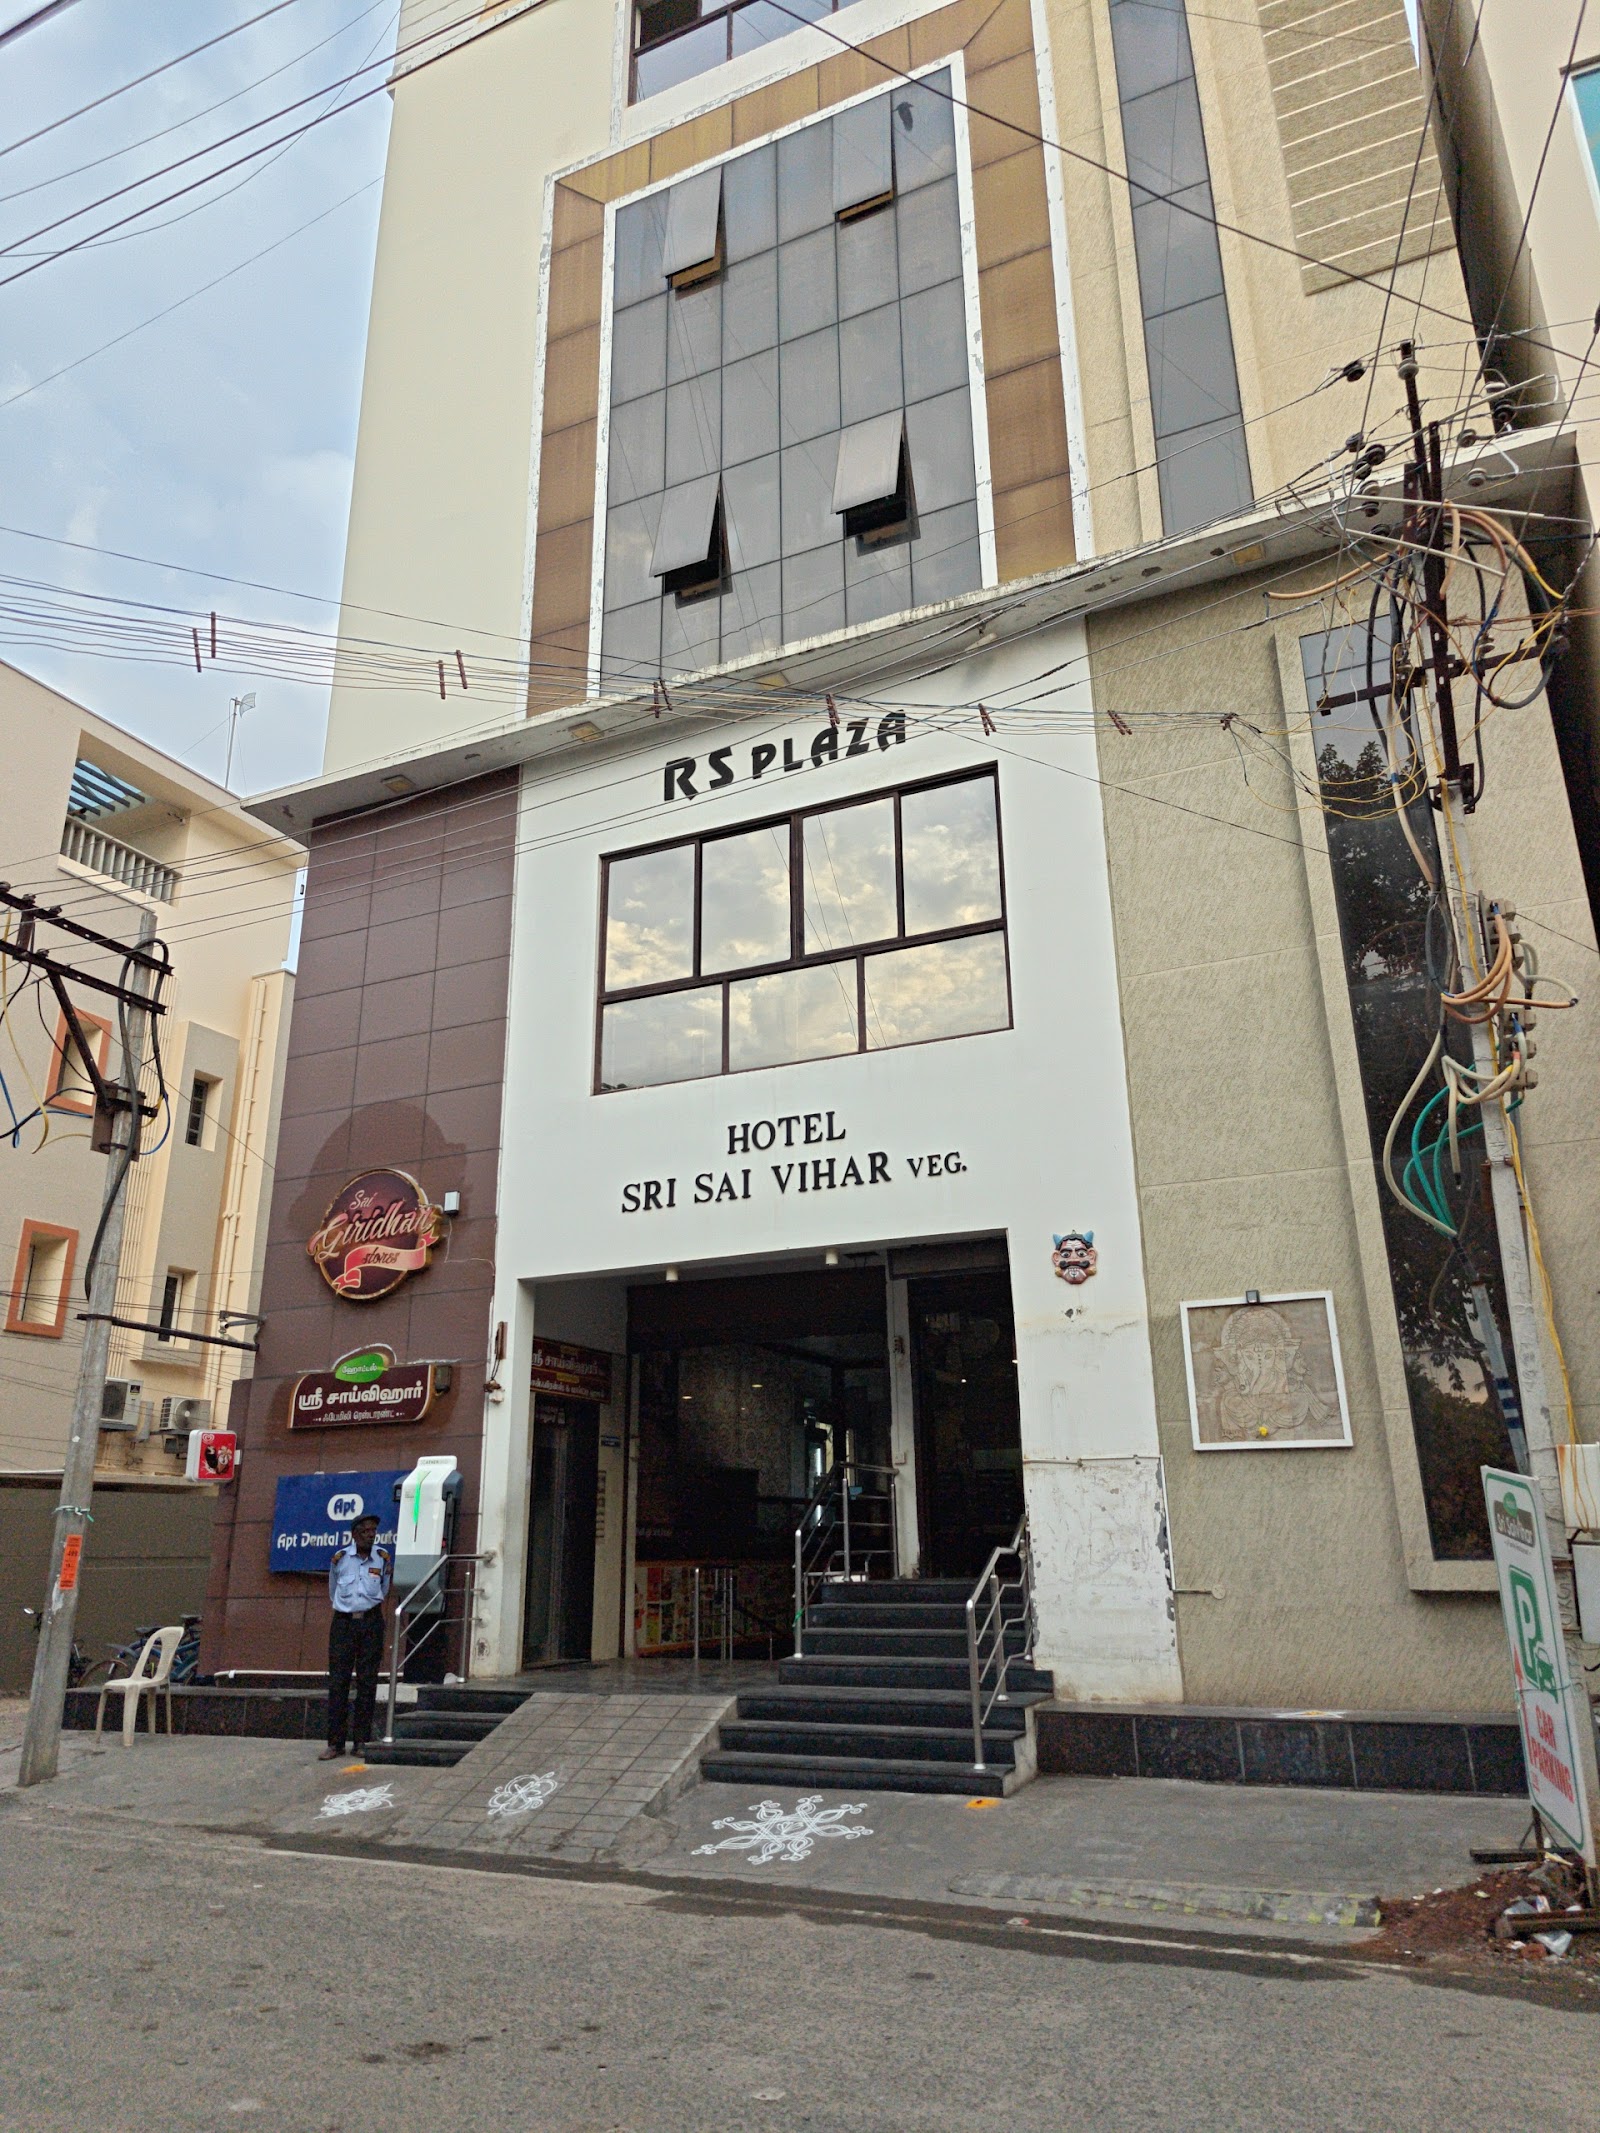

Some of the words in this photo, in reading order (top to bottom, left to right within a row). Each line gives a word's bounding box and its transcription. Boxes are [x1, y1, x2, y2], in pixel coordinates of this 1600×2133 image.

[751, 709, 906, 780] PLAZA
[727, 1110, 847, 1155] HOTEL
[349, 1189, 378, 1210] Sai
[621, 1178, 677, 1213] SRI
[694, 1168, 752, 1204] SAI
[771, 1151, 892, 1195] VIHAR
[906, 1151, 967, 1178] VEG.
[307, 1198, 434, 1260] Giridhar
[362, 1247, 401, 1265] stores
[327, 1380, 423, 1405] சாய்விஹார்
[333, 1498, 356, 1517] Apt
[277, 1533, 298, 1551] Apt
[301, 1531, 339, 1548] Dental
[1535, 1704, 1558, 1751] CAR
[1530, 1736, 1575, 1804] PARKING
